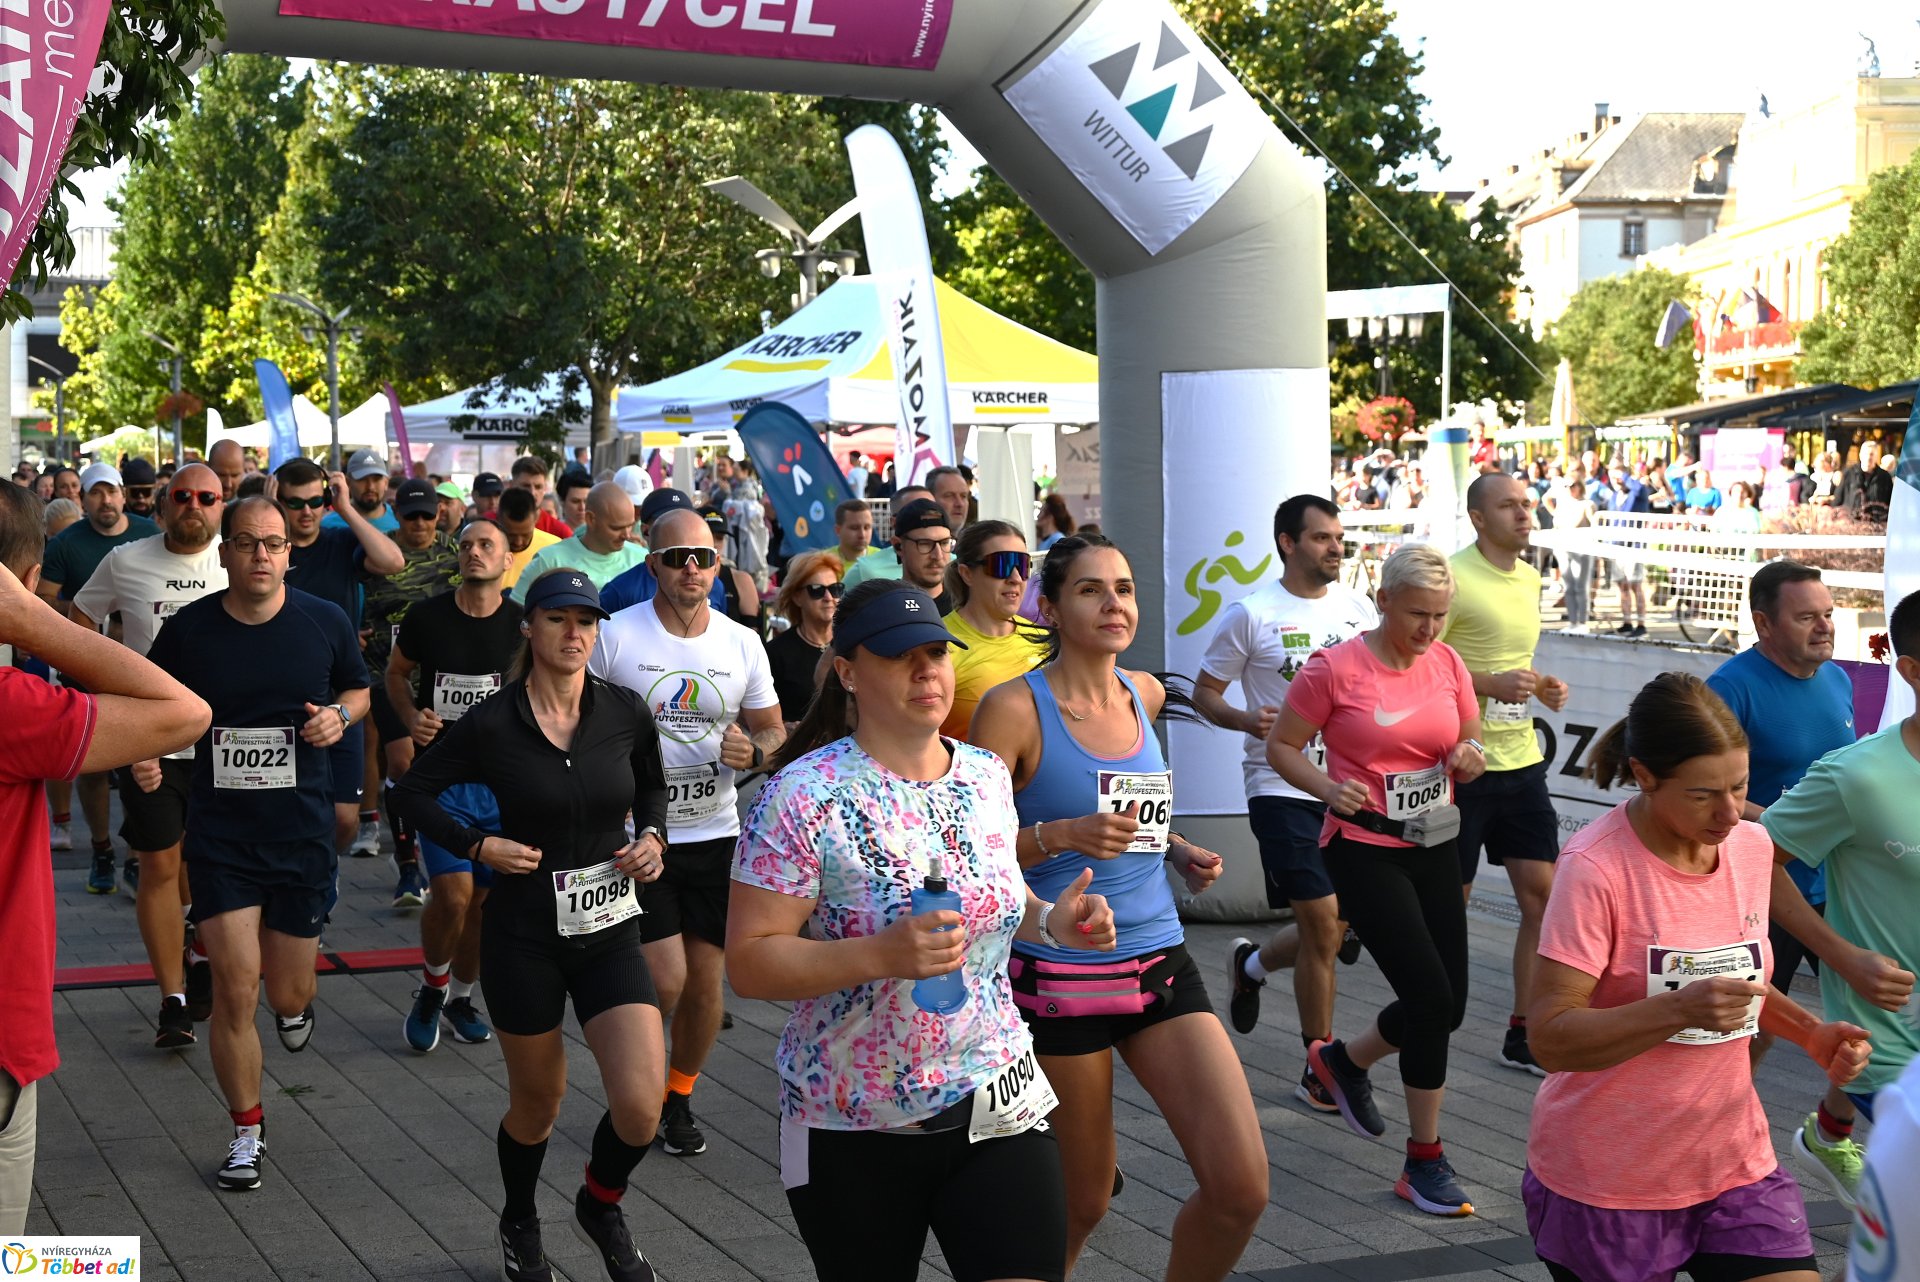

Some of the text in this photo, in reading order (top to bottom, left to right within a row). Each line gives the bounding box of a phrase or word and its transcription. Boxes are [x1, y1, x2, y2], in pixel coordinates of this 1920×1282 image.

[1083, 109, 1150, 183] WITTUR
[742, 331, 862, 358] KÄRCHER
[973, 391, 1048, 404] KÄRCHER
[165, 580, 206, 591] RUN
[221, 748, 289, 768] 10022
[668, 779, 716, 803] 0136
[1396, 777, 1447, 811] 10081
[567, 876, 630, 913] 10098
[986, 1050, 1034, 1112] 10090
